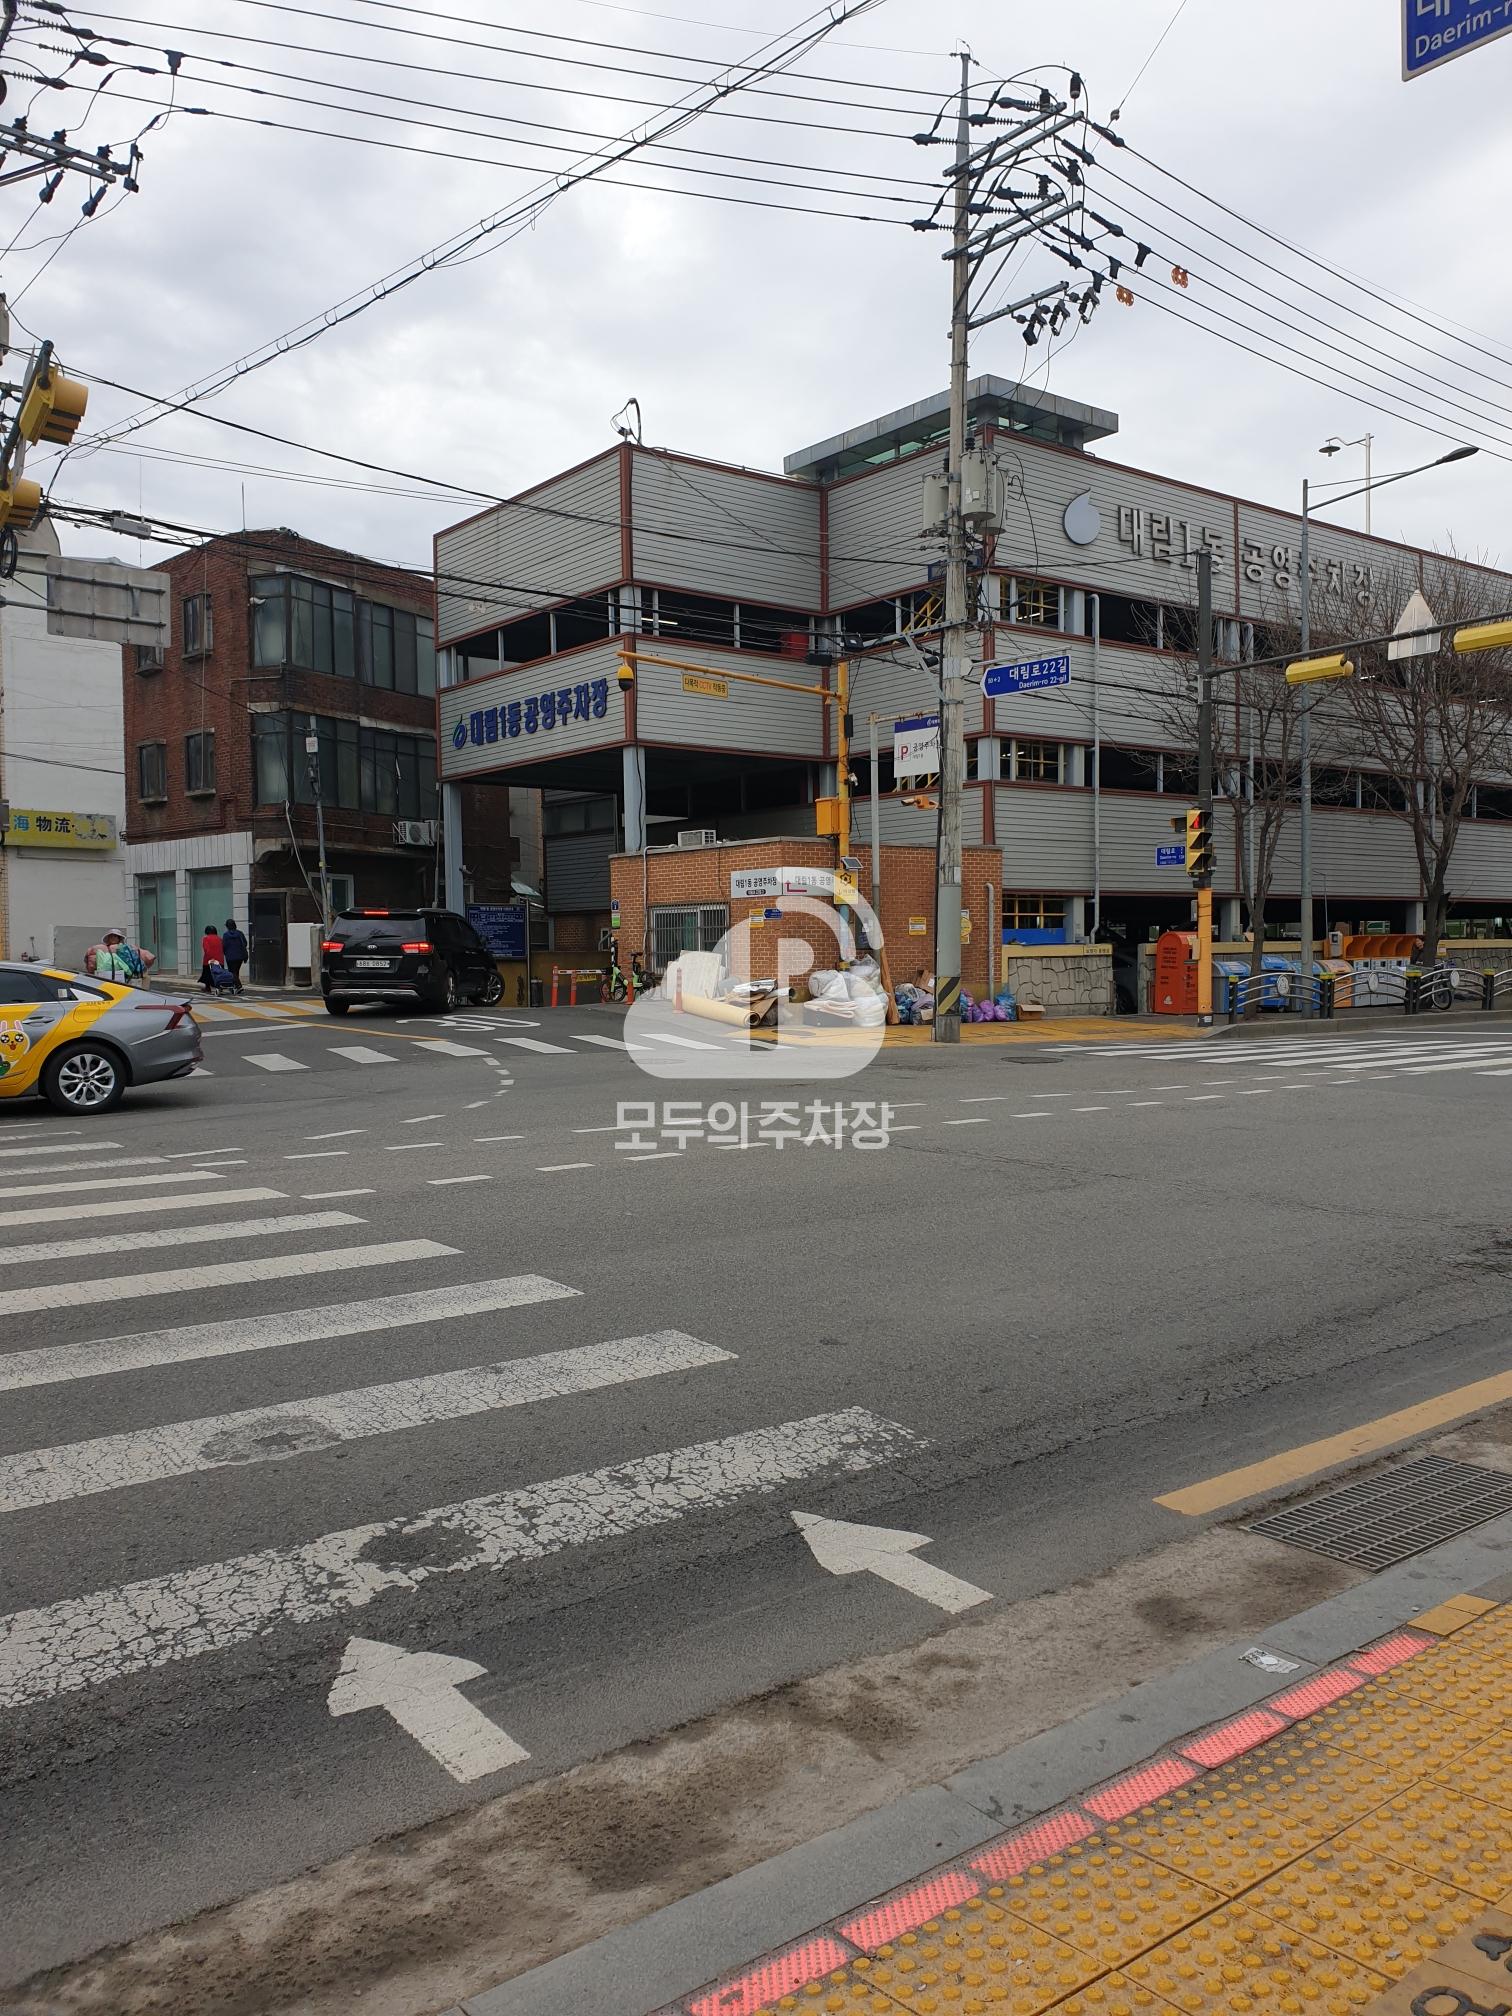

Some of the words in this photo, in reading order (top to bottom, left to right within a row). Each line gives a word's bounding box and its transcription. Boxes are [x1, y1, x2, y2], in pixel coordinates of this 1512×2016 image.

[1118, 505, 1224, 573] 대림1동
[1009, 658, 1067, 681] 대림로22길
[1018, 679, 1049, 689] Daerim-ro
[1050, 675, 1067, 684] 22-gil
